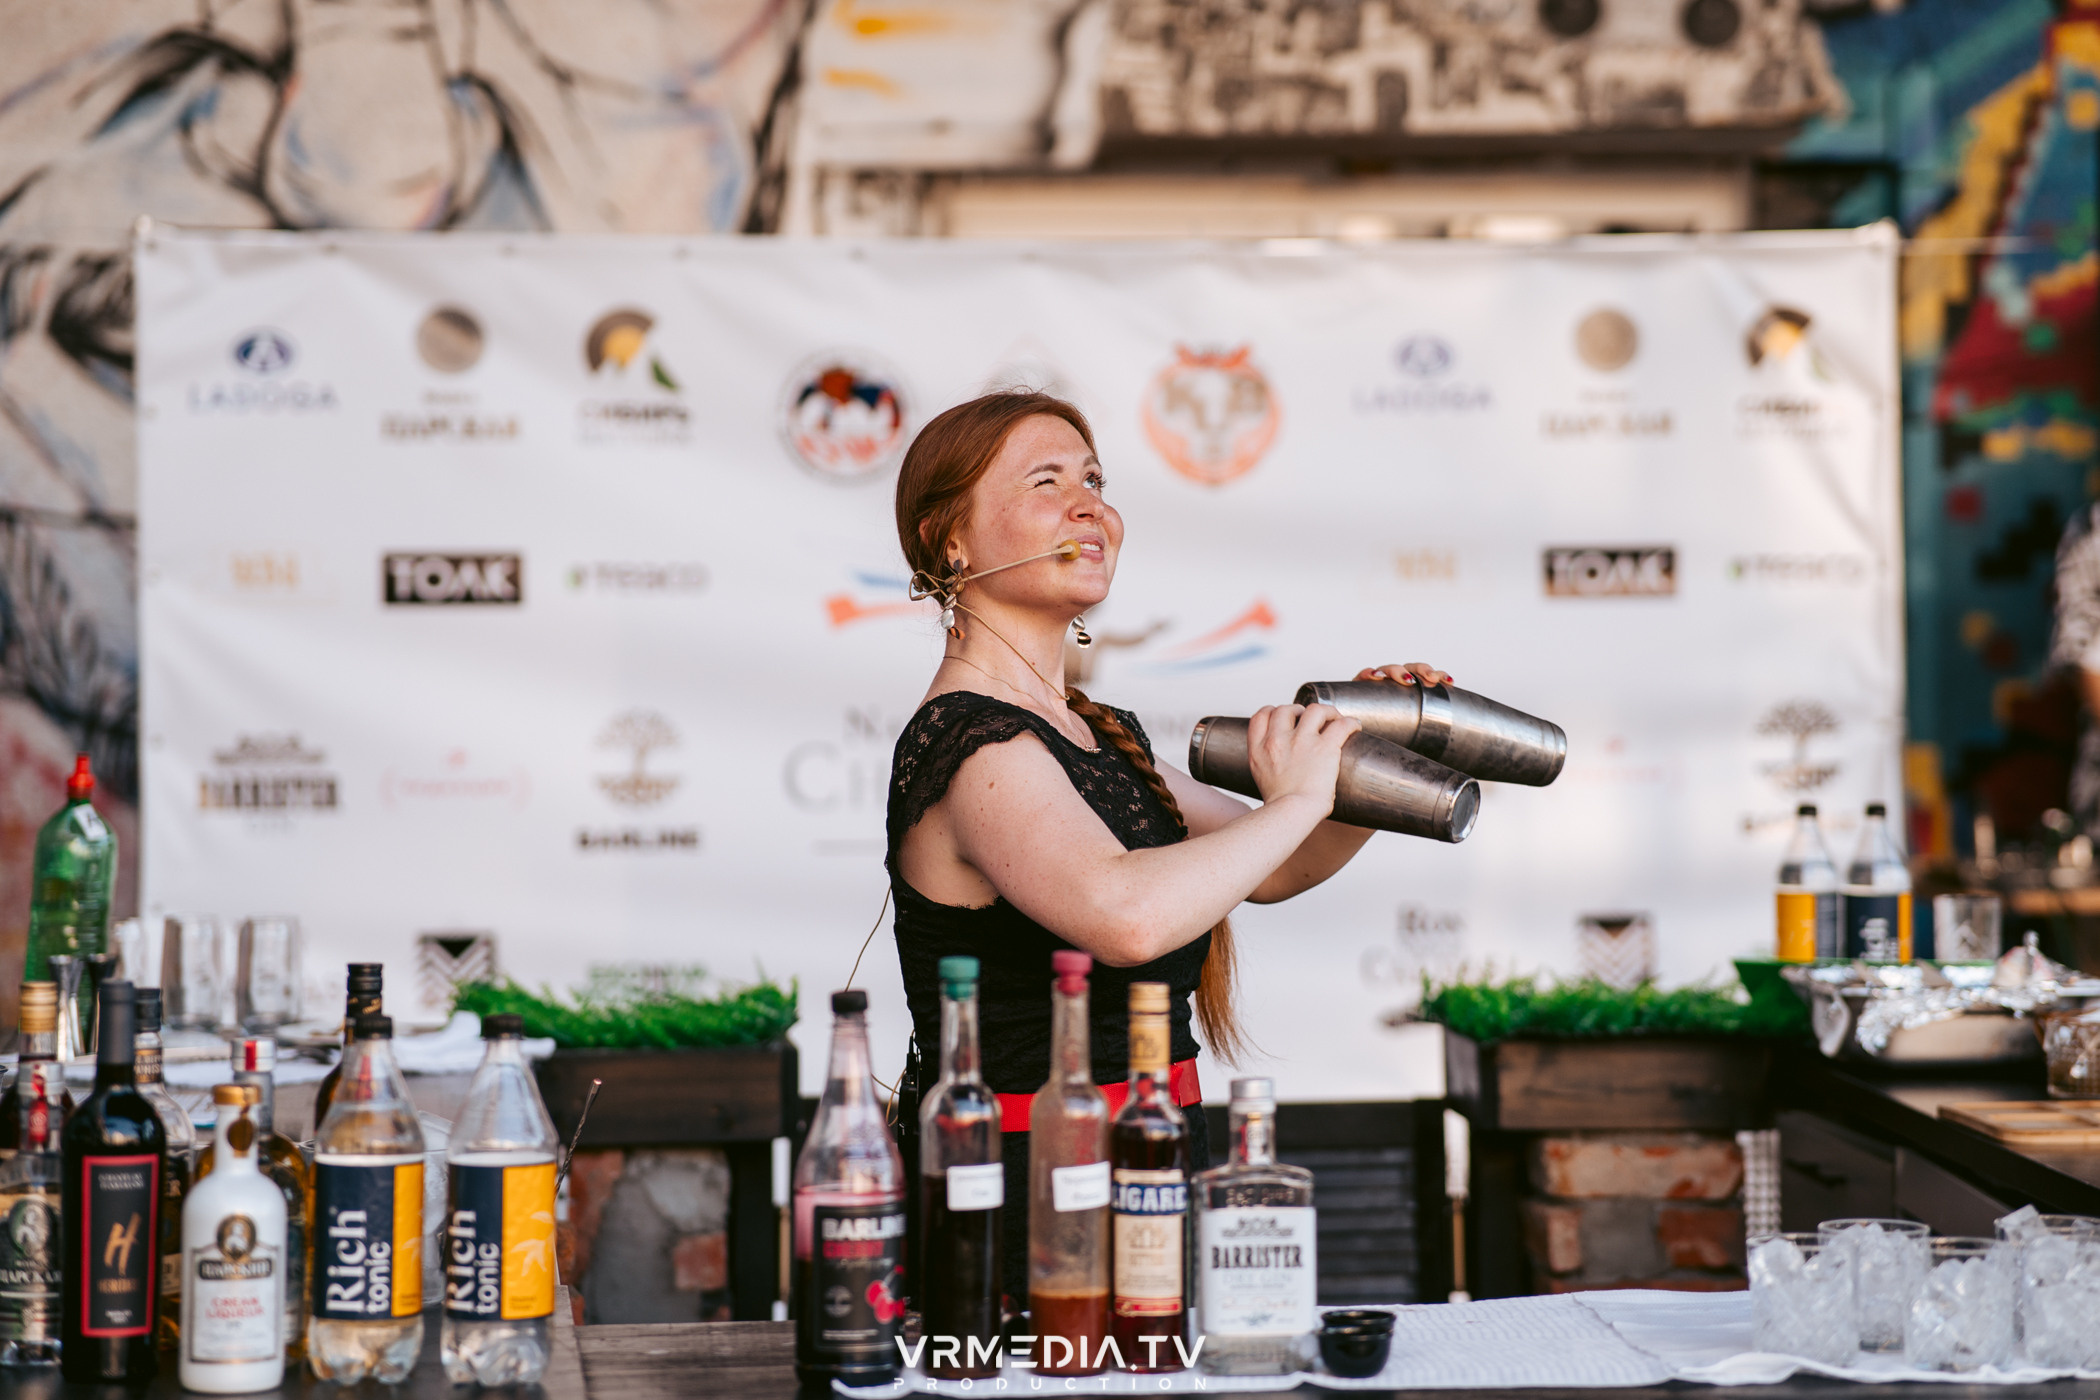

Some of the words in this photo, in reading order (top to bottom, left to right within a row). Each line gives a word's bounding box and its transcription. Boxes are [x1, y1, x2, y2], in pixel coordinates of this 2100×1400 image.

[326, 1209, 368, 1313] Rich
[363, 1240, 391, 1315] tonic
[446, 1209, 477, 1313] Rich
[473, 1241, 501, 1315] tonic
[1211, 1245, 1304, 1269] BARRISTER
